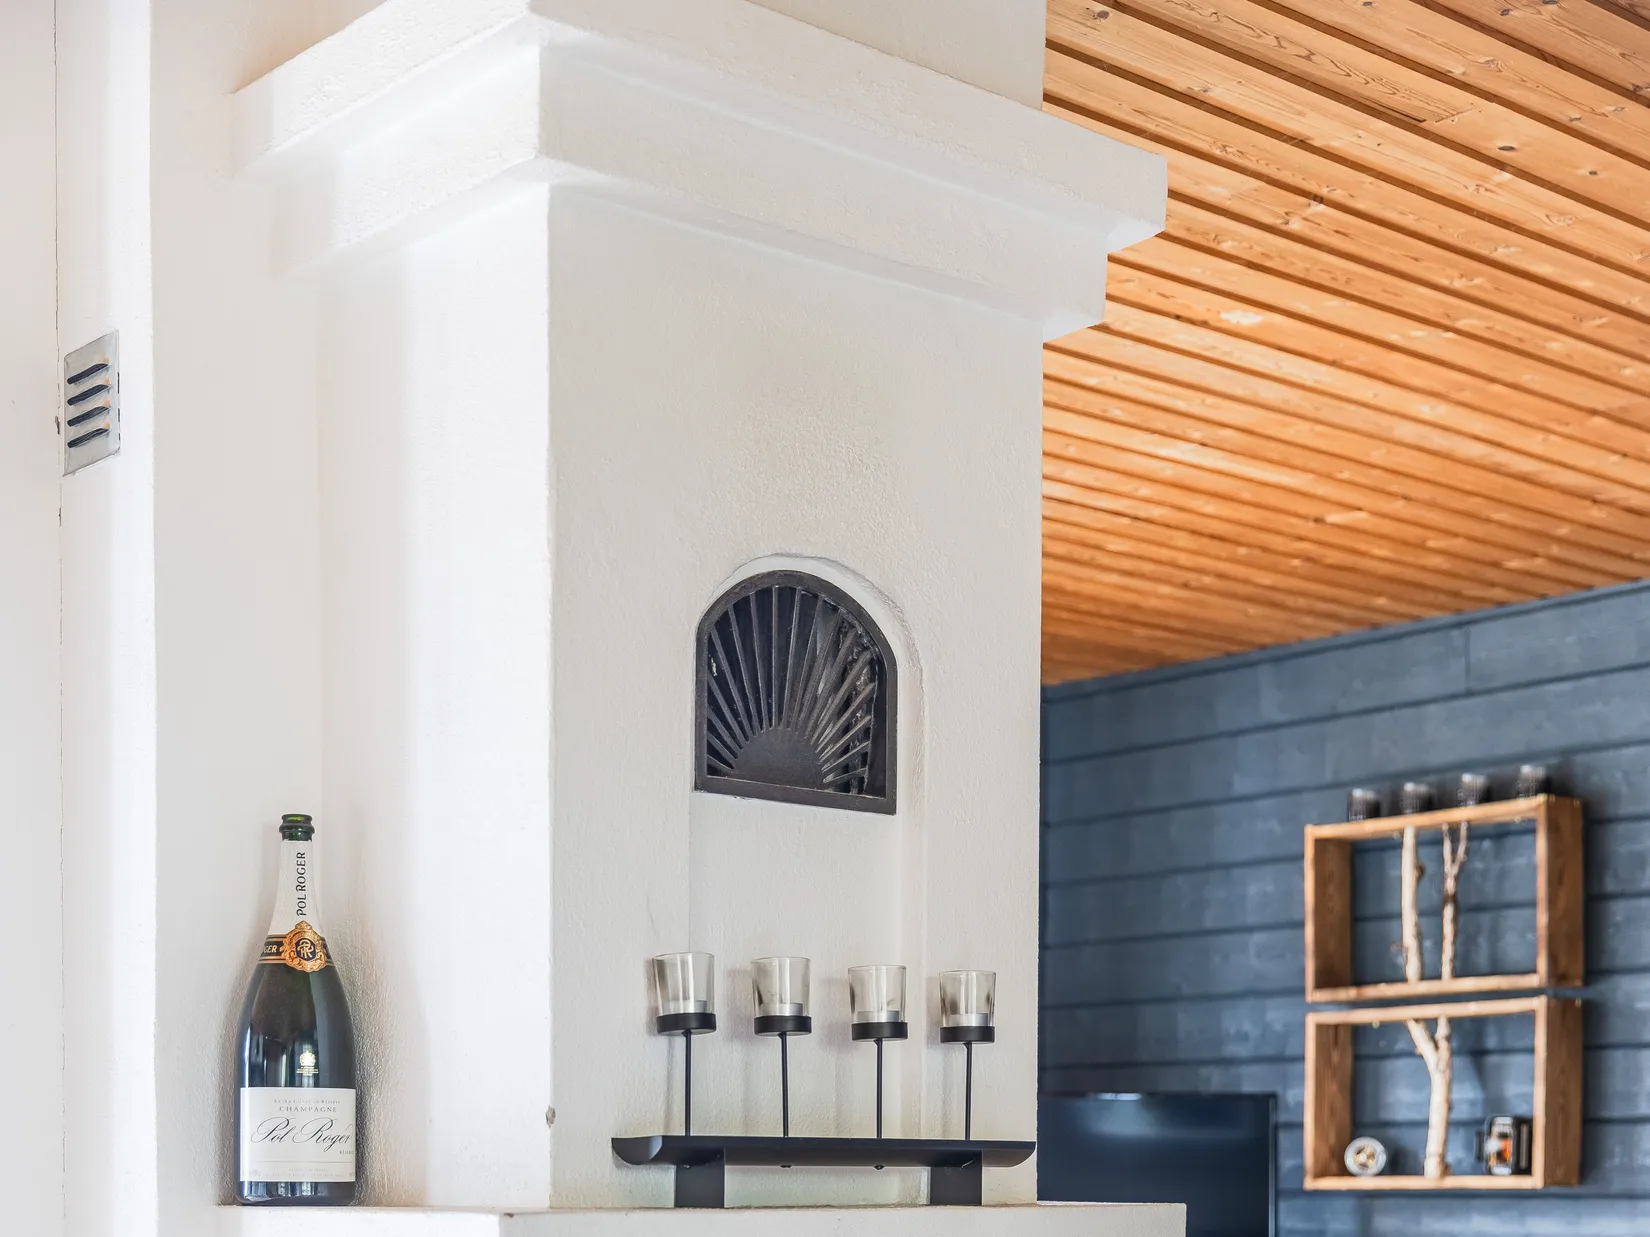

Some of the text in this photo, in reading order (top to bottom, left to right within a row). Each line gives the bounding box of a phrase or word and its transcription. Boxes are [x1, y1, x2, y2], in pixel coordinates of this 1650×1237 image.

[295, 852, 307, 916] POL ROGER
[279, 1105, 337, 1113] CHAMPAGNE
[250, 1116, 355, 1153] Pol Roger
